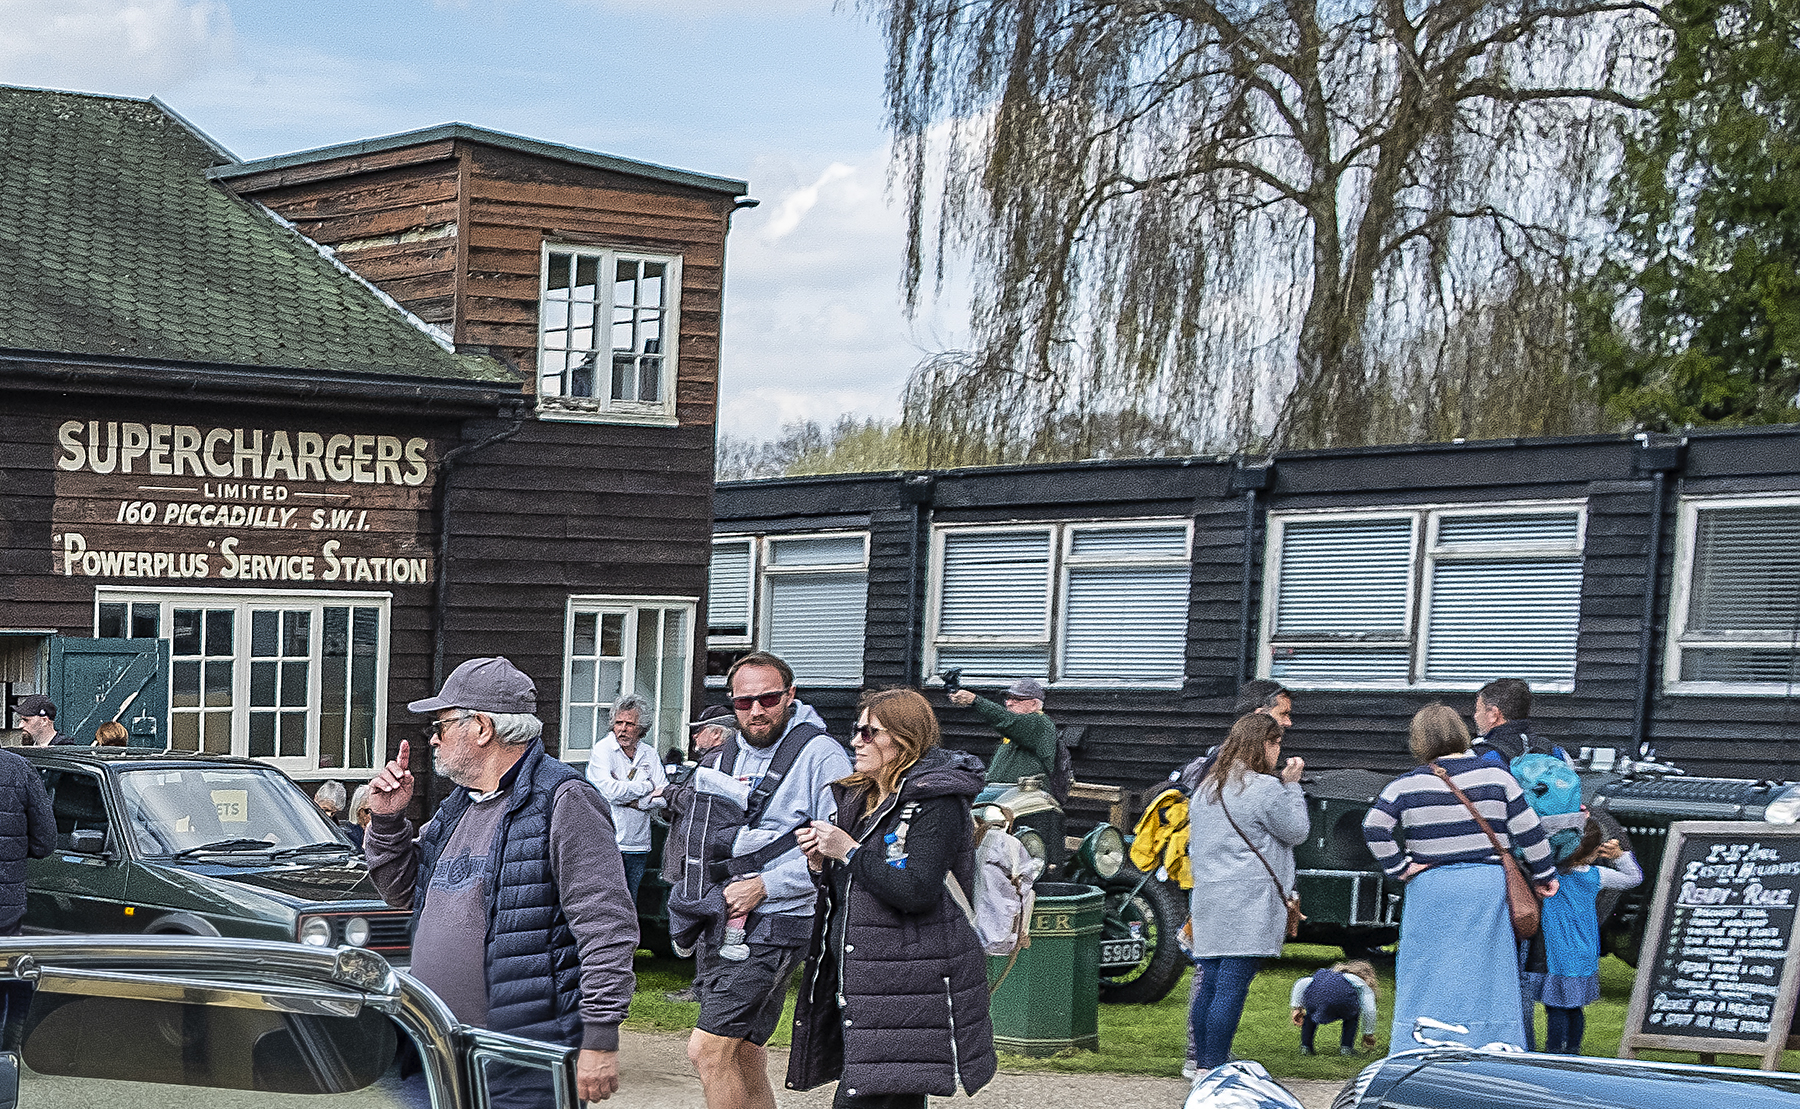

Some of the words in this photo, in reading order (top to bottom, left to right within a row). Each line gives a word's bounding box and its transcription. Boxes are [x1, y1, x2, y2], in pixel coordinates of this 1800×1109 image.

[57, 421, 428, 486] SUPERCHARGERS
[203, 482, 288, 502] LIMITED
[115, 500, 157, 525] 160
[219, 536, 316, 581] SERVICE
[321, 539, 427, 584] STATION
